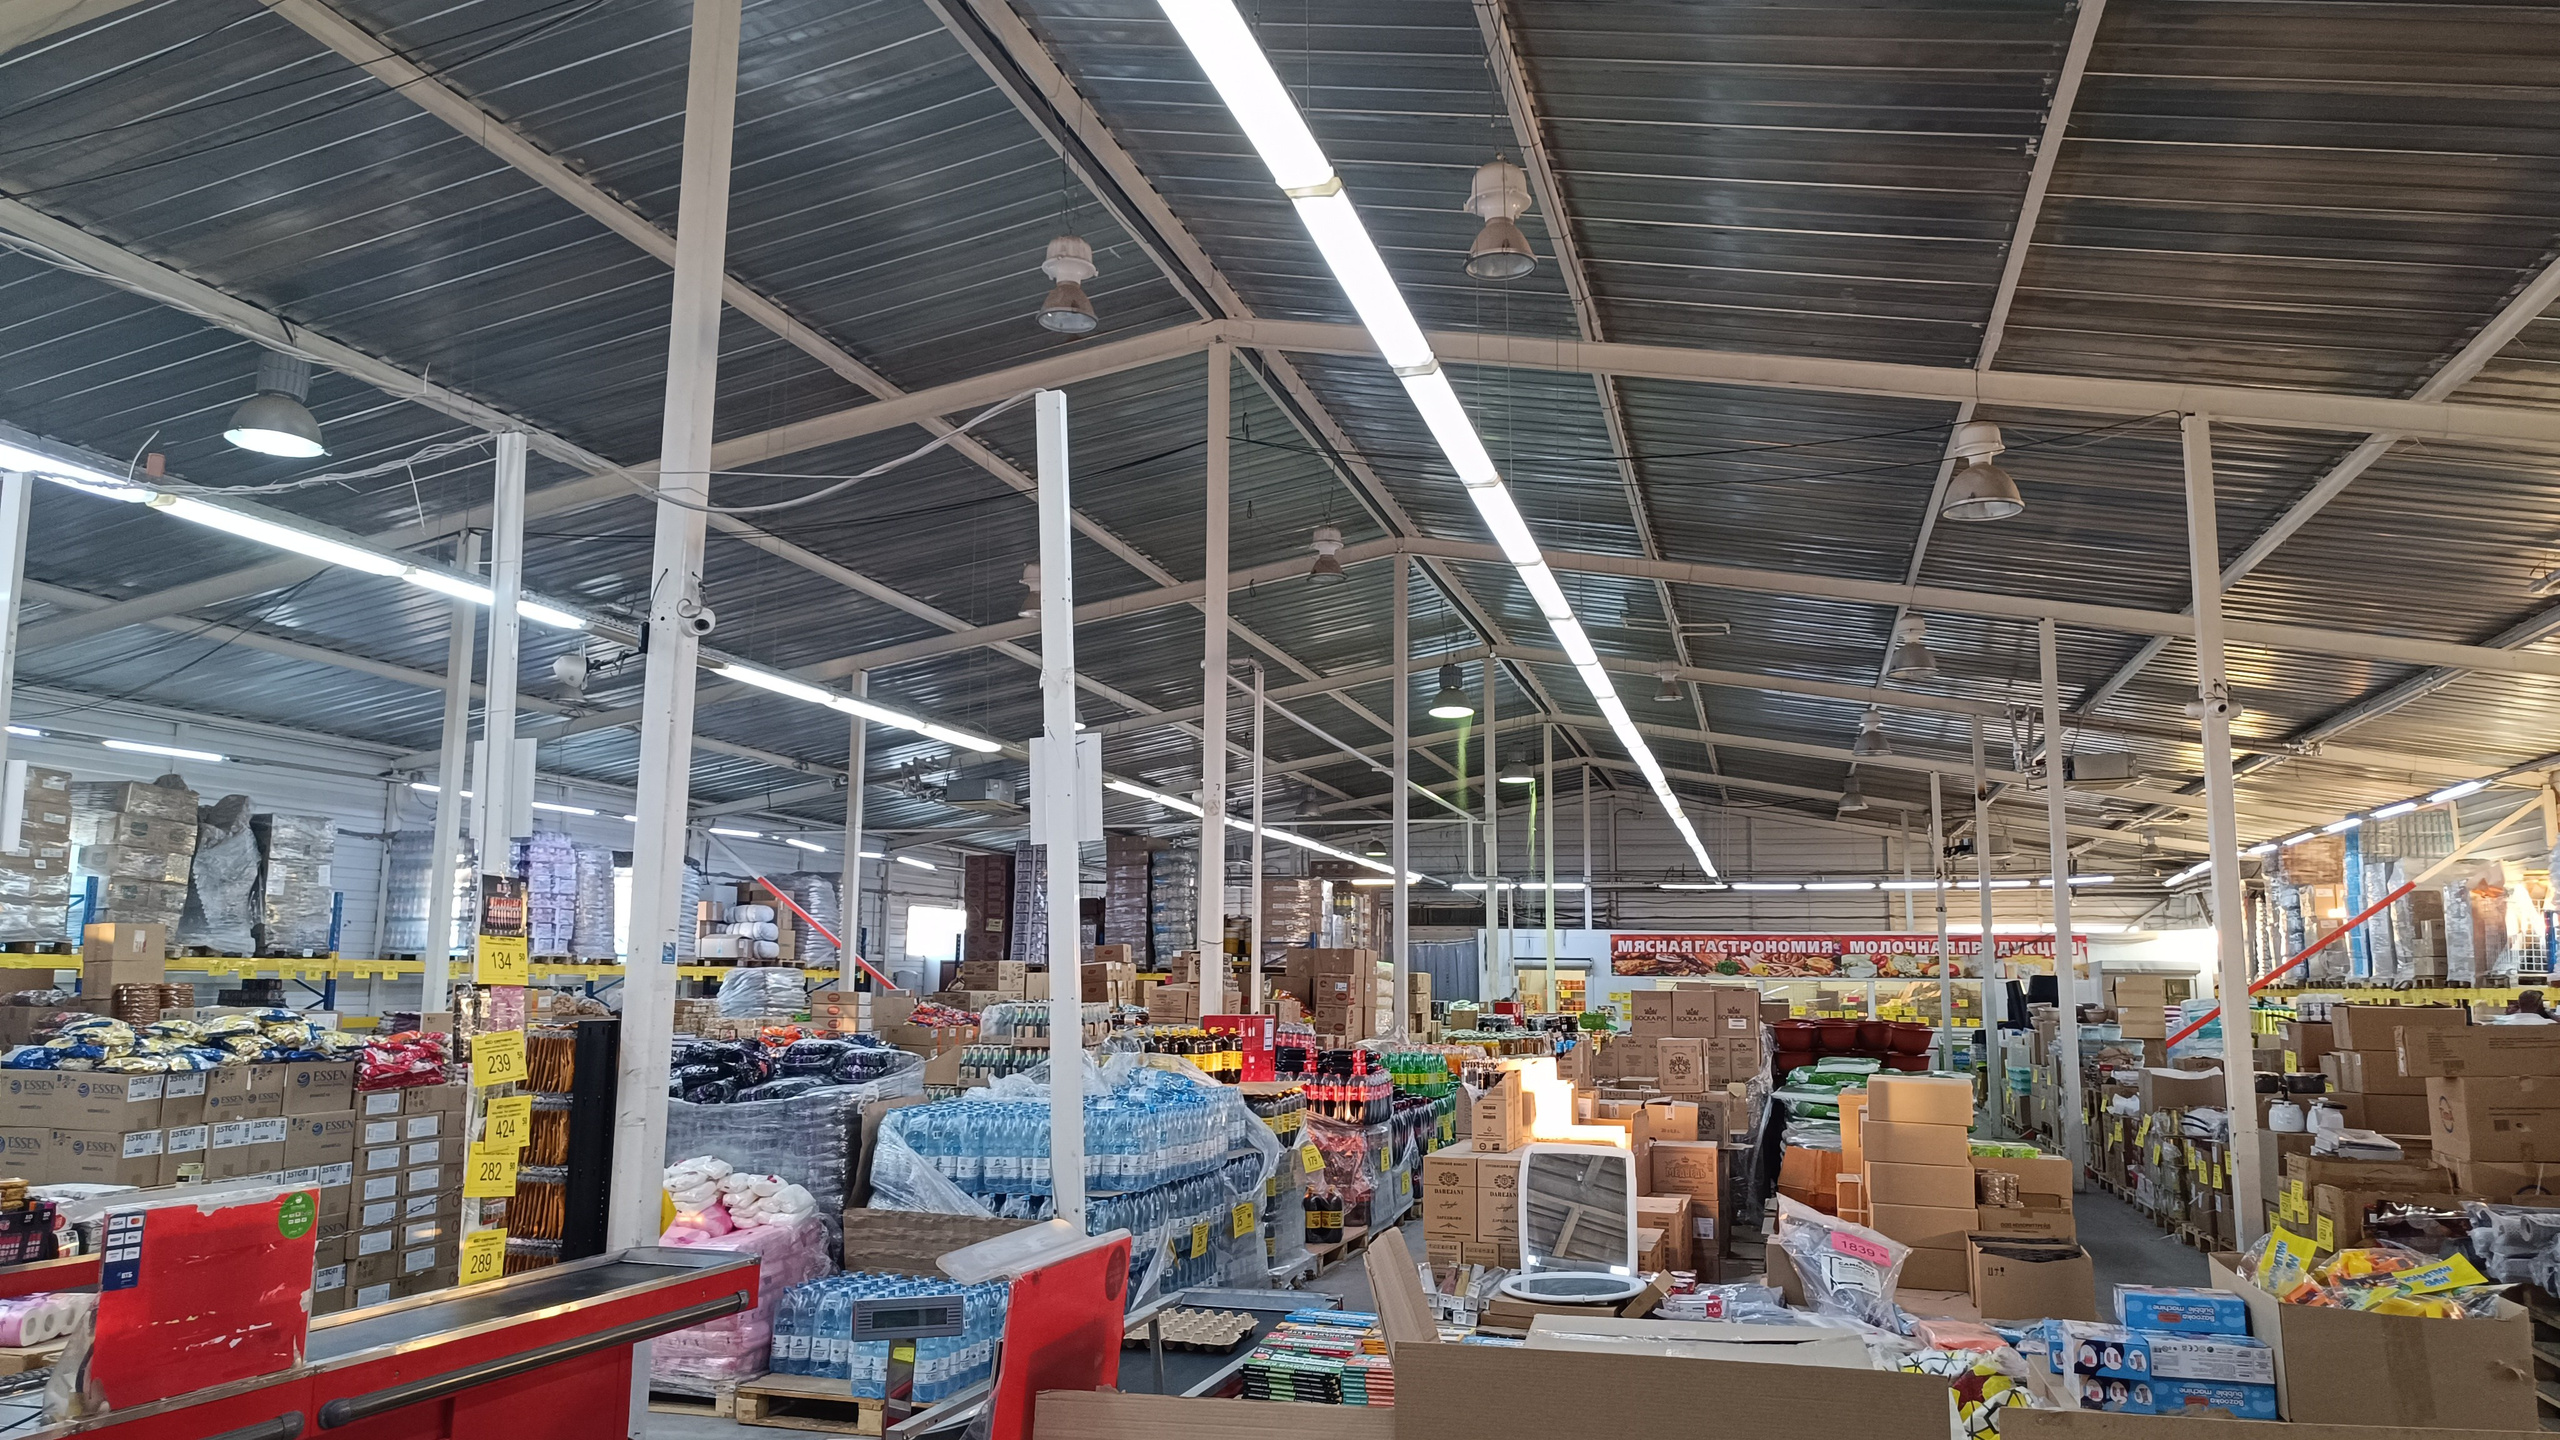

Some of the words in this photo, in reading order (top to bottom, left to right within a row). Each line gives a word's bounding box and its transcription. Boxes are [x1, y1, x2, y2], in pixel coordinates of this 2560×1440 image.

[1617, 940, 1693, 953] МЯСНАЯ
[1695, 940, 1833, 954] ГАСТРОНОМИЯ
[491, 951, 512, 970] 134
[487, 1053, 511, 1074] 239
[313, 1069, 348, 1081] ESSEN
[24, 1079, 55, 1090] ESSEN
[92, 1084, 124, 1095] ESSEN
[325, 1119, 354, 1131] ESSEN
[495, 1118, 515, 1139] 424
[8, 1136, 41, 1150] ESSEN
[86, 1140, 117, 1153] ESSEN
[479, 1161, 502, 1181] 282
[1841, 1240, 1875, 1257] 1839
[470, 1253, 492, 1275] 289
[2153, 1304, 2185, 1313] machine
[2188, 1305, 2215, 1315] bubble
[2182, 1312, 2215, 1322] Bazooka
[2178, 1387, 2212, 1396] machine
[2216, 1389, 2243, 1398] bubble
[2210, 1396, 2245, 1407] Bazooka
